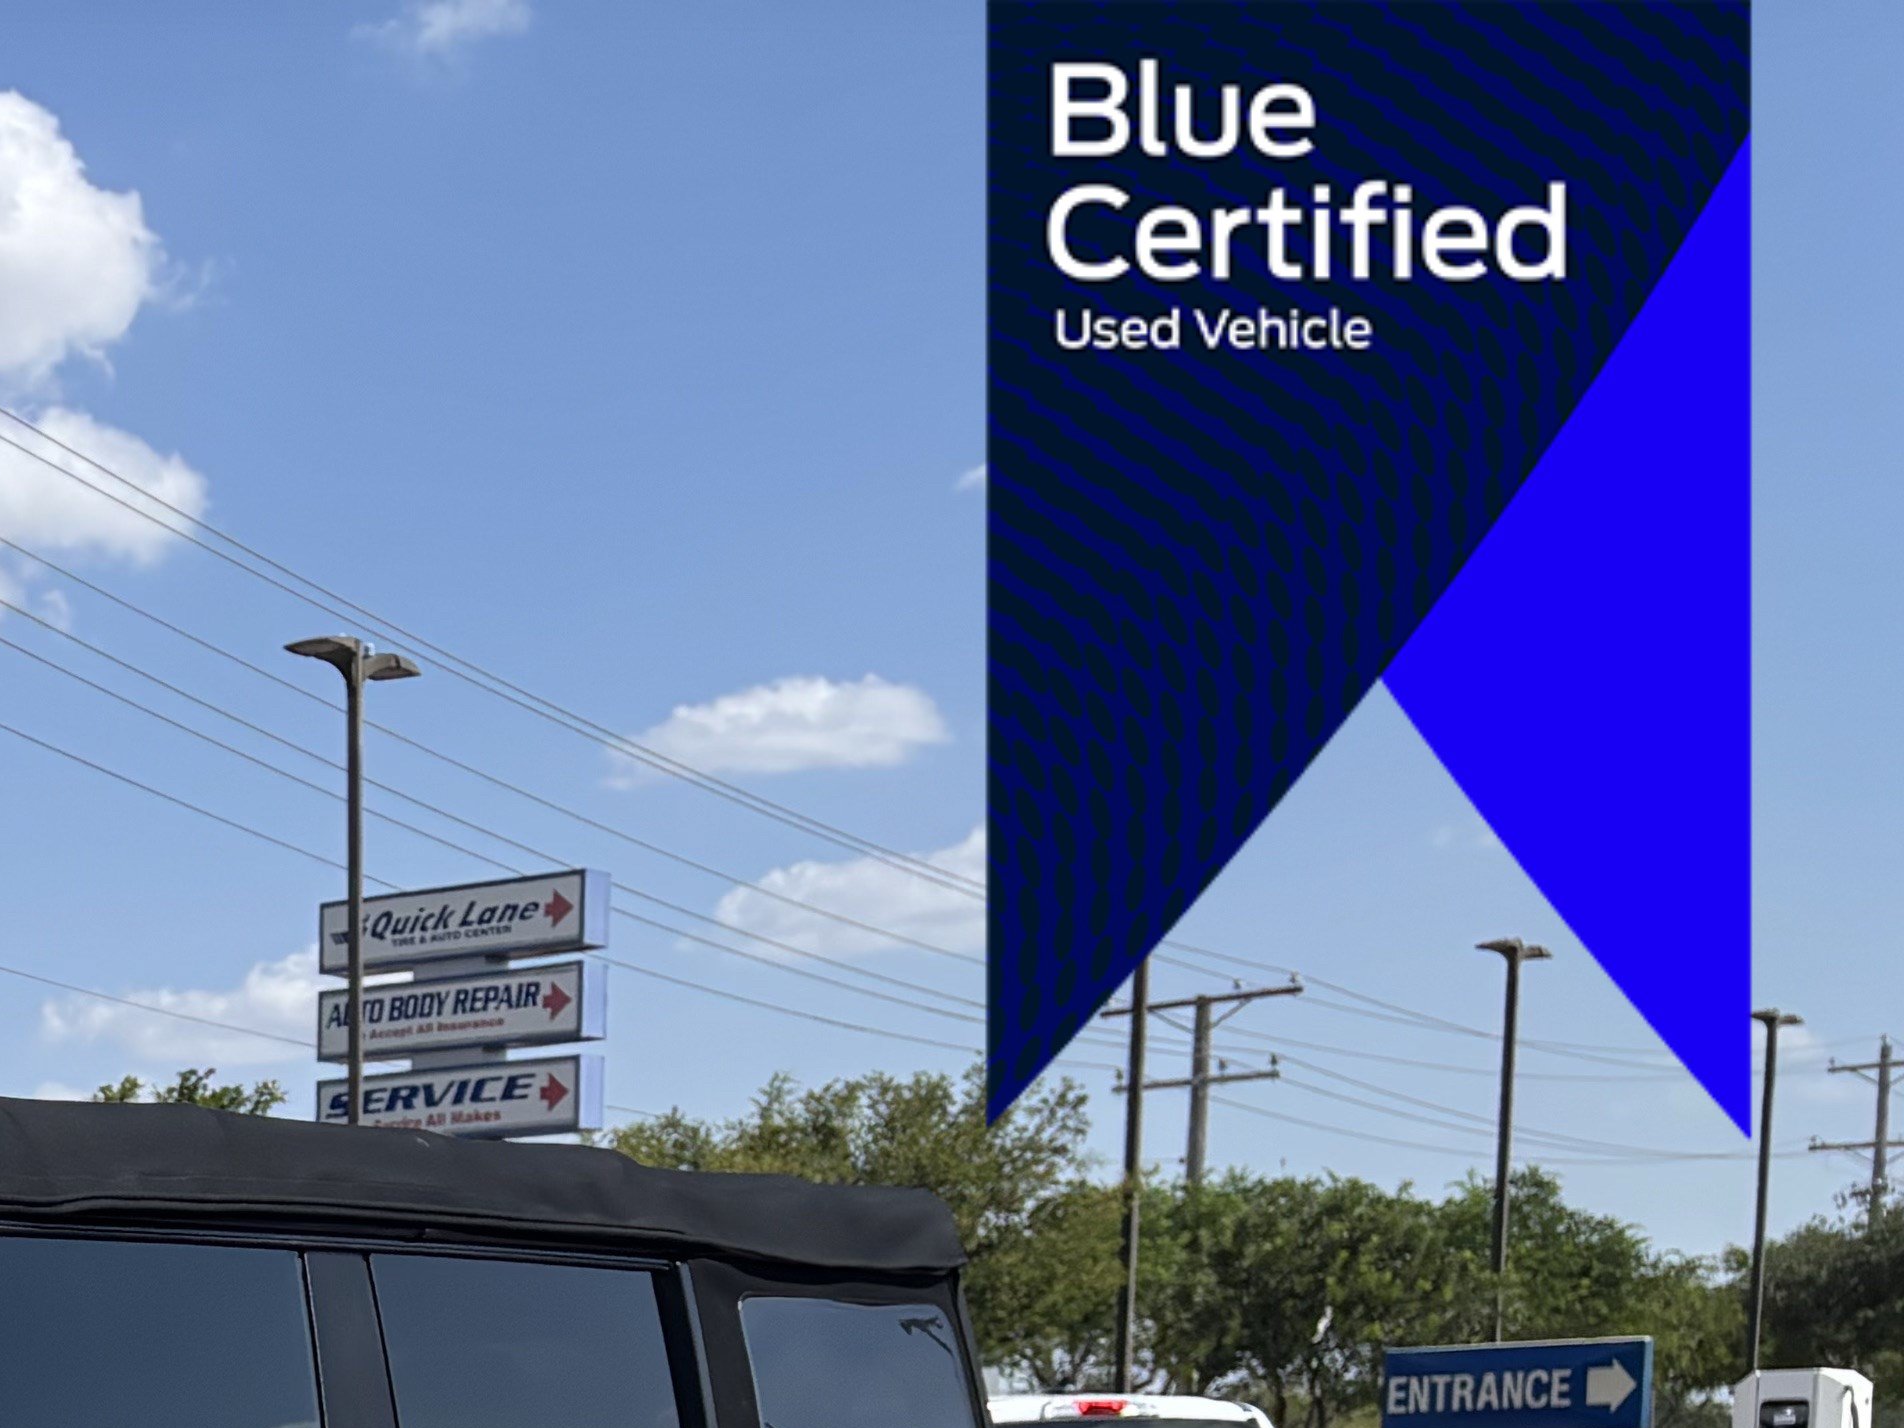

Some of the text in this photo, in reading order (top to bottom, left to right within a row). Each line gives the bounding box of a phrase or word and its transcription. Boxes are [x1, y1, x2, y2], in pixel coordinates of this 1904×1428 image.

[370, 901, 540, 940] Quick Lane
[391, 935, 417, 947] TIRE
[430, 930, 462, 943] AUTO
[464, 925, 512, 940] CENTER
[389, 992, 449, 1021] BODY
[452, 981, 540, 1016] REPAIR
[1386, 1368, 1572, 1415] ENTRANCE
